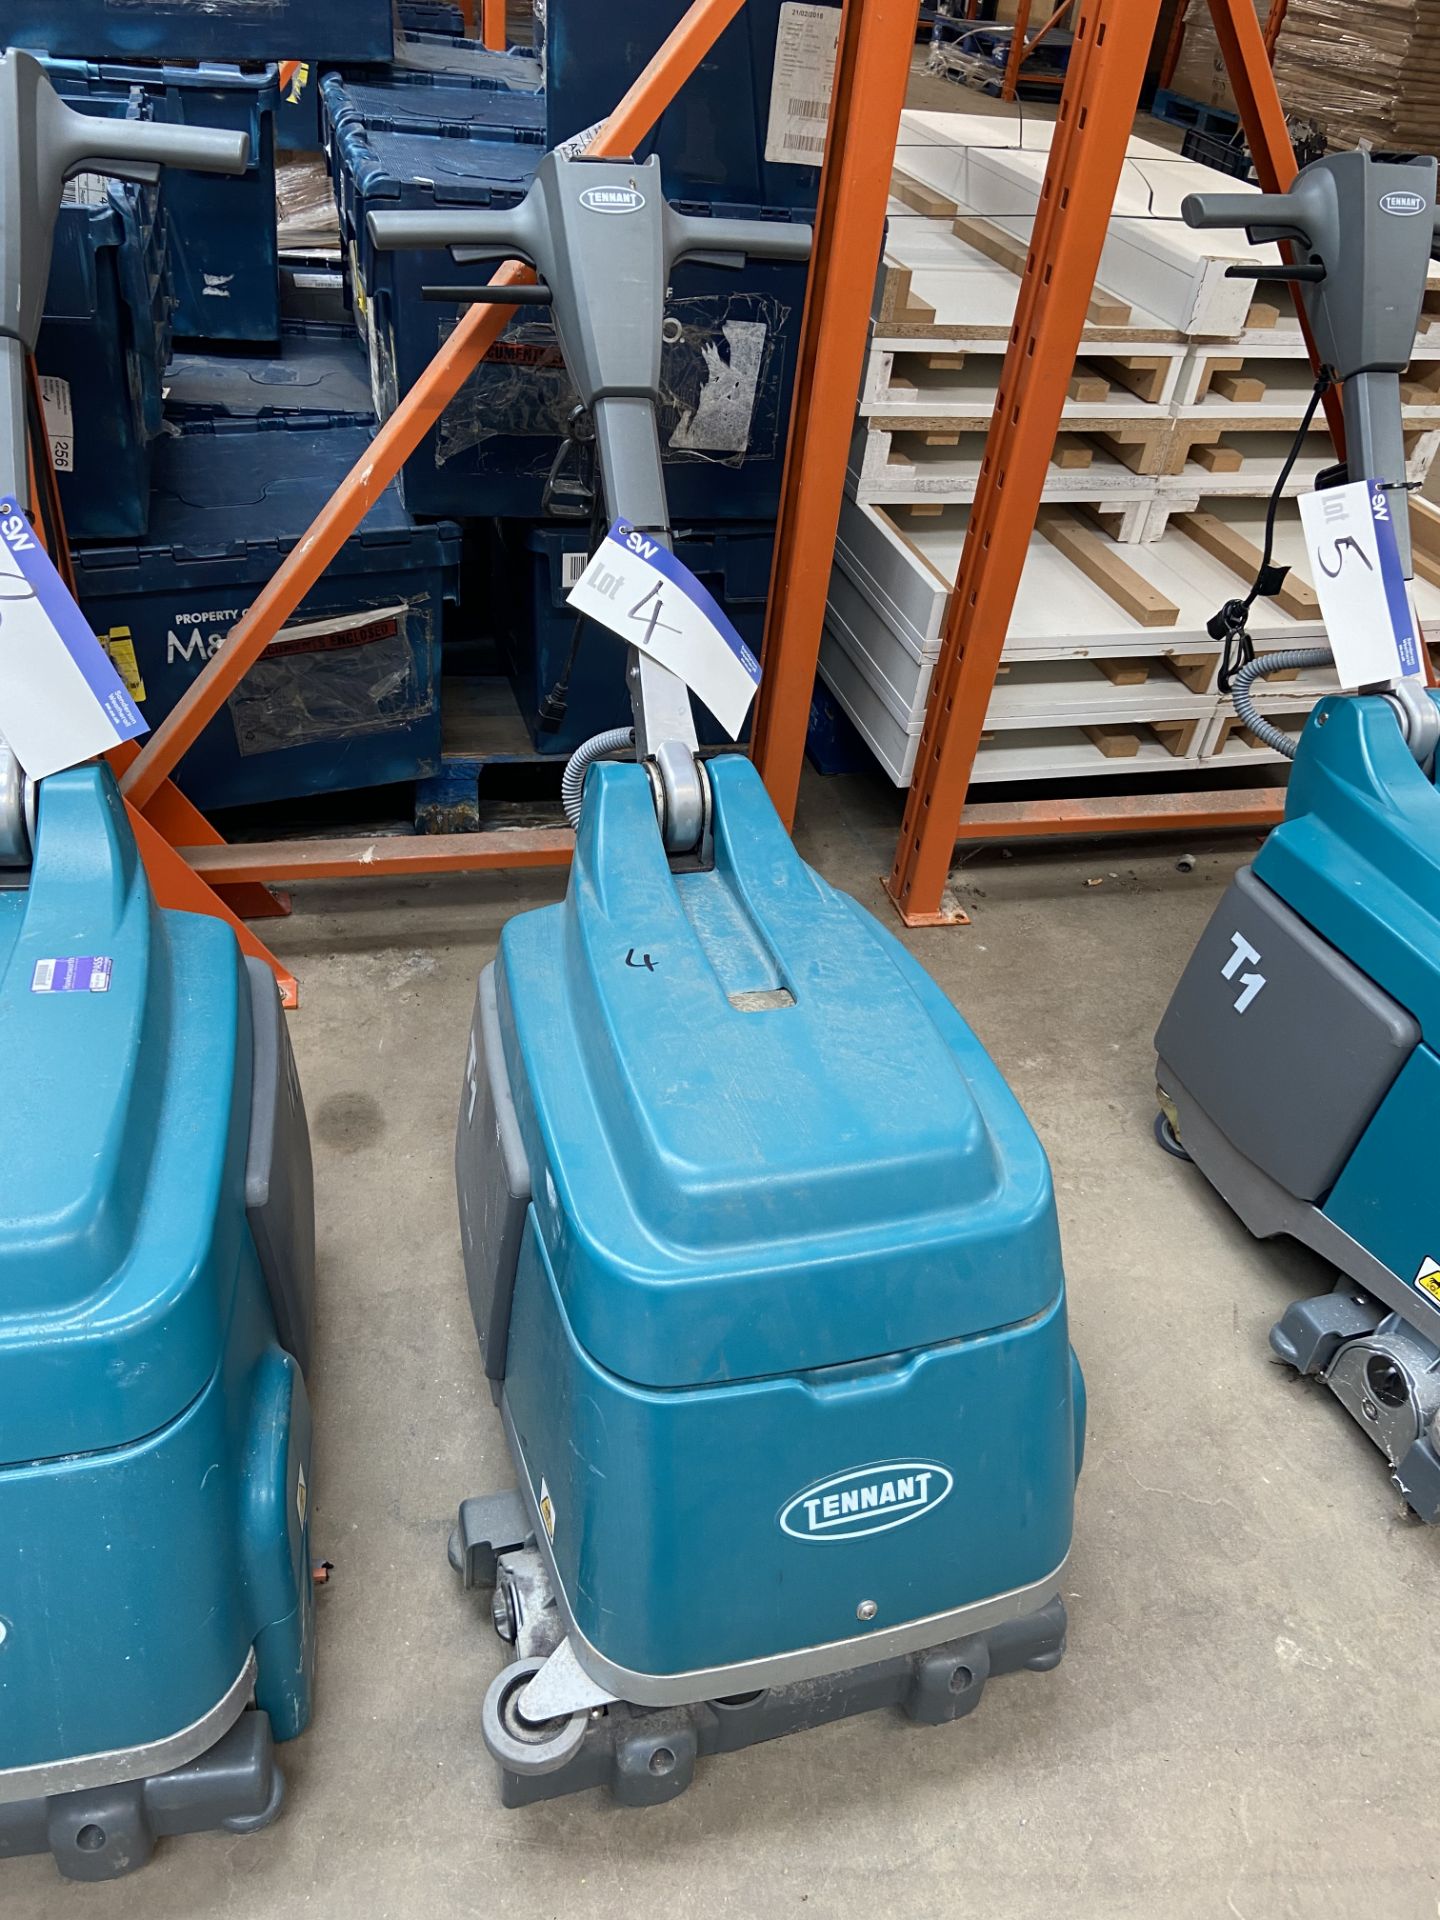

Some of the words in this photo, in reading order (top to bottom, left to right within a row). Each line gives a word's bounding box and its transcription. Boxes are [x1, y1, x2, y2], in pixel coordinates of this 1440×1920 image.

[587, 192, 637, 207] TENNANT
[1385, 197, 1421, 210] TENNANT
[54, 441, 69, 468] 256
[1321, 492, 1349, 525] Lot
[1317, 535, 1374, 579] 5
[586, 559, 626, 601] Lot
[175, 609, 239, 625] PROPERTY
[627, 579, 683, 645] 4
[625, 948, 661, 972] 4
[1220, 930, 1267, 1014] T1
[802, 1471, 933, 1531] TENNANT
